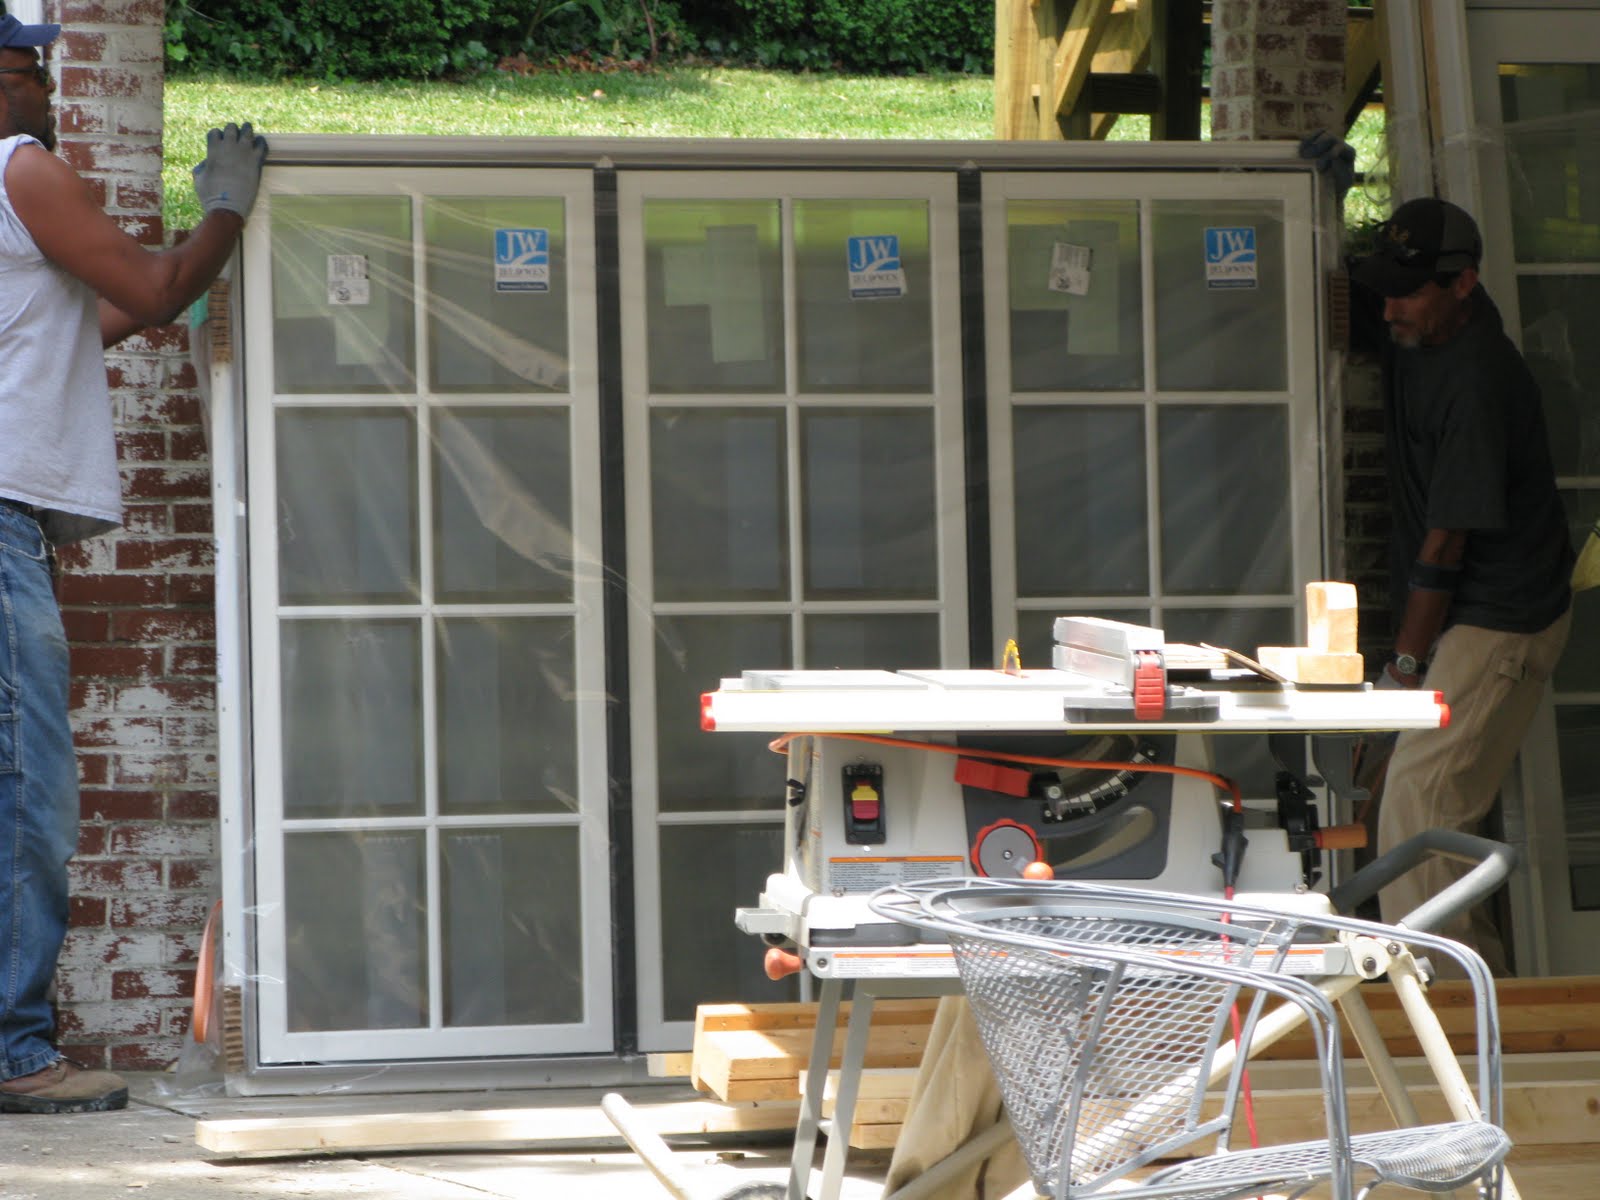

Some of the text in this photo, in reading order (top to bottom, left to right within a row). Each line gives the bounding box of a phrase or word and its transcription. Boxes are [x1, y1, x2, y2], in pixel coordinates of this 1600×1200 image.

[500, 232, 543, 262] JW
[853, 238, 893, 269] JW
[1210, 231, 1249, 260] JW
